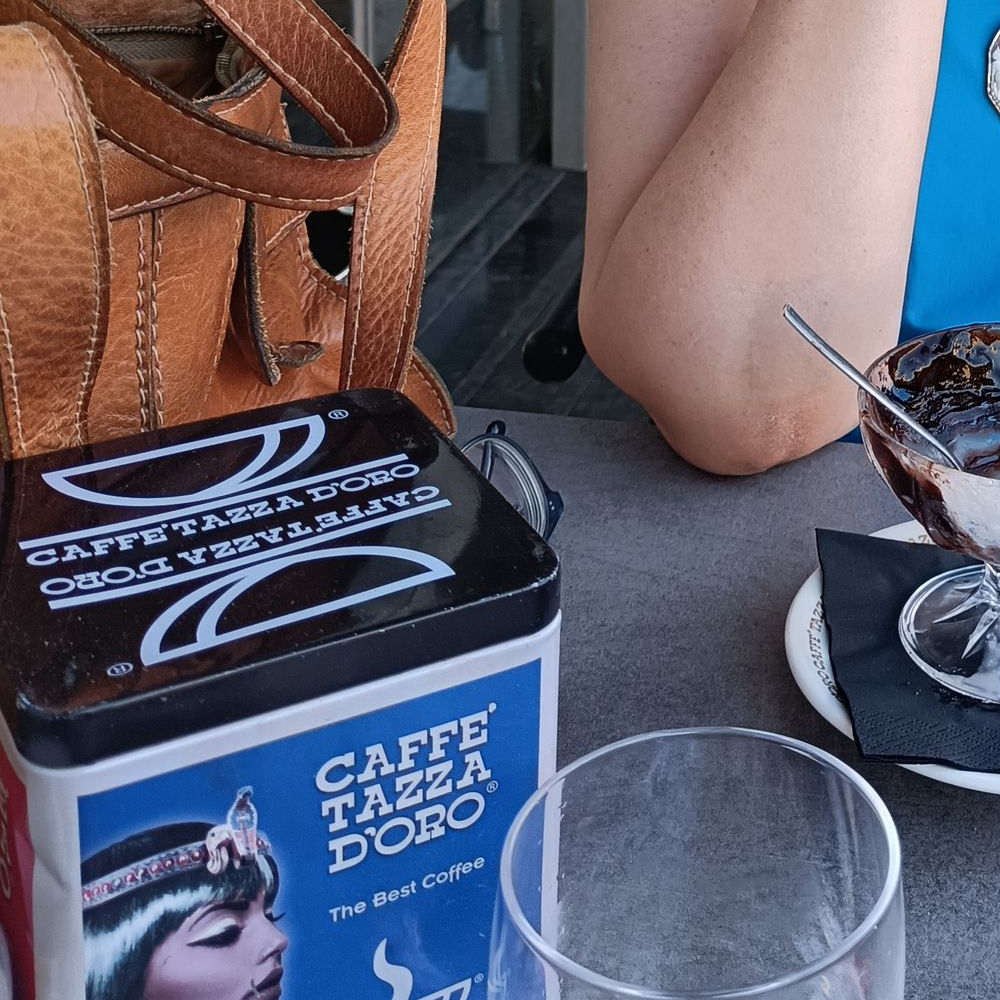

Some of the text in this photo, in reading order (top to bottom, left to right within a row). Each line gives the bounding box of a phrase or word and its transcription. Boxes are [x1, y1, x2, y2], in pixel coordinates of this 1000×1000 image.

[171, 495, 305, 537] TAZZA
[306, 463, 420, 503] D'ORO
[39, 556, 174, 595] D'ORO
[177, 521, 313, 565] TAZZA
[321, 750, 492, 833] TAZZA
[328, 791, 486, 875] D'ORO
[328, 856, 486, 923] The Best Coffee
